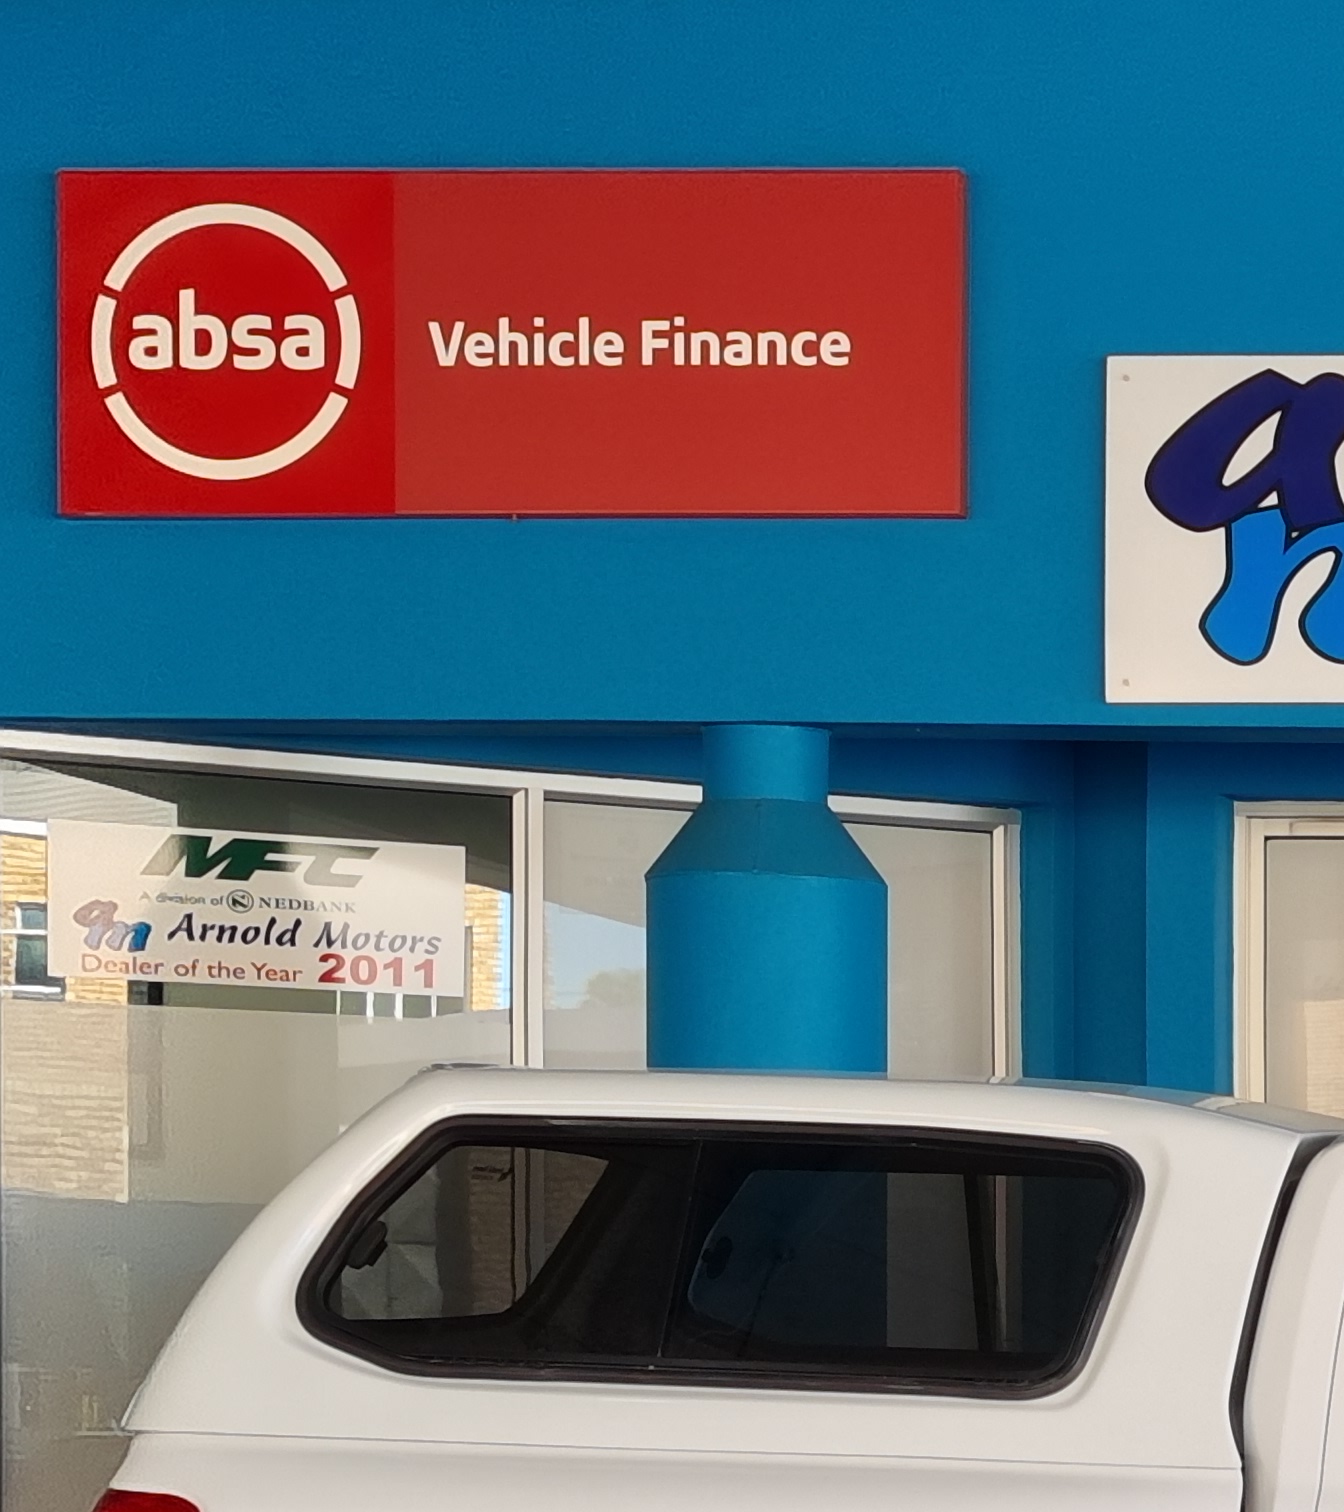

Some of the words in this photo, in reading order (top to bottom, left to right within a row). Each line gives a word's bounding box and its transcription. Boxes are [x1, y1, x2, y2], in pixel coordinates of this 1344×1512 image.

[129, 289, 325, 371] absa
[428, 317, 624, 367] Vehicle
[642, 317, 850, 367] Finance
[140, 834, 380, 888] MFC
[210, 895, 224, 906] of
[258, 896, 356, 914] NEDBANK
[167, 912, 303, 948] Arnold
[312, 921, 442, 956] Motors
[81, 953, 164, 976] Dealer
[174, 958, 199, 977] of
[207, 961, 246, 980] the
[250, 961, 303, 982] Year
[318, 952, 434, 989] 2011
